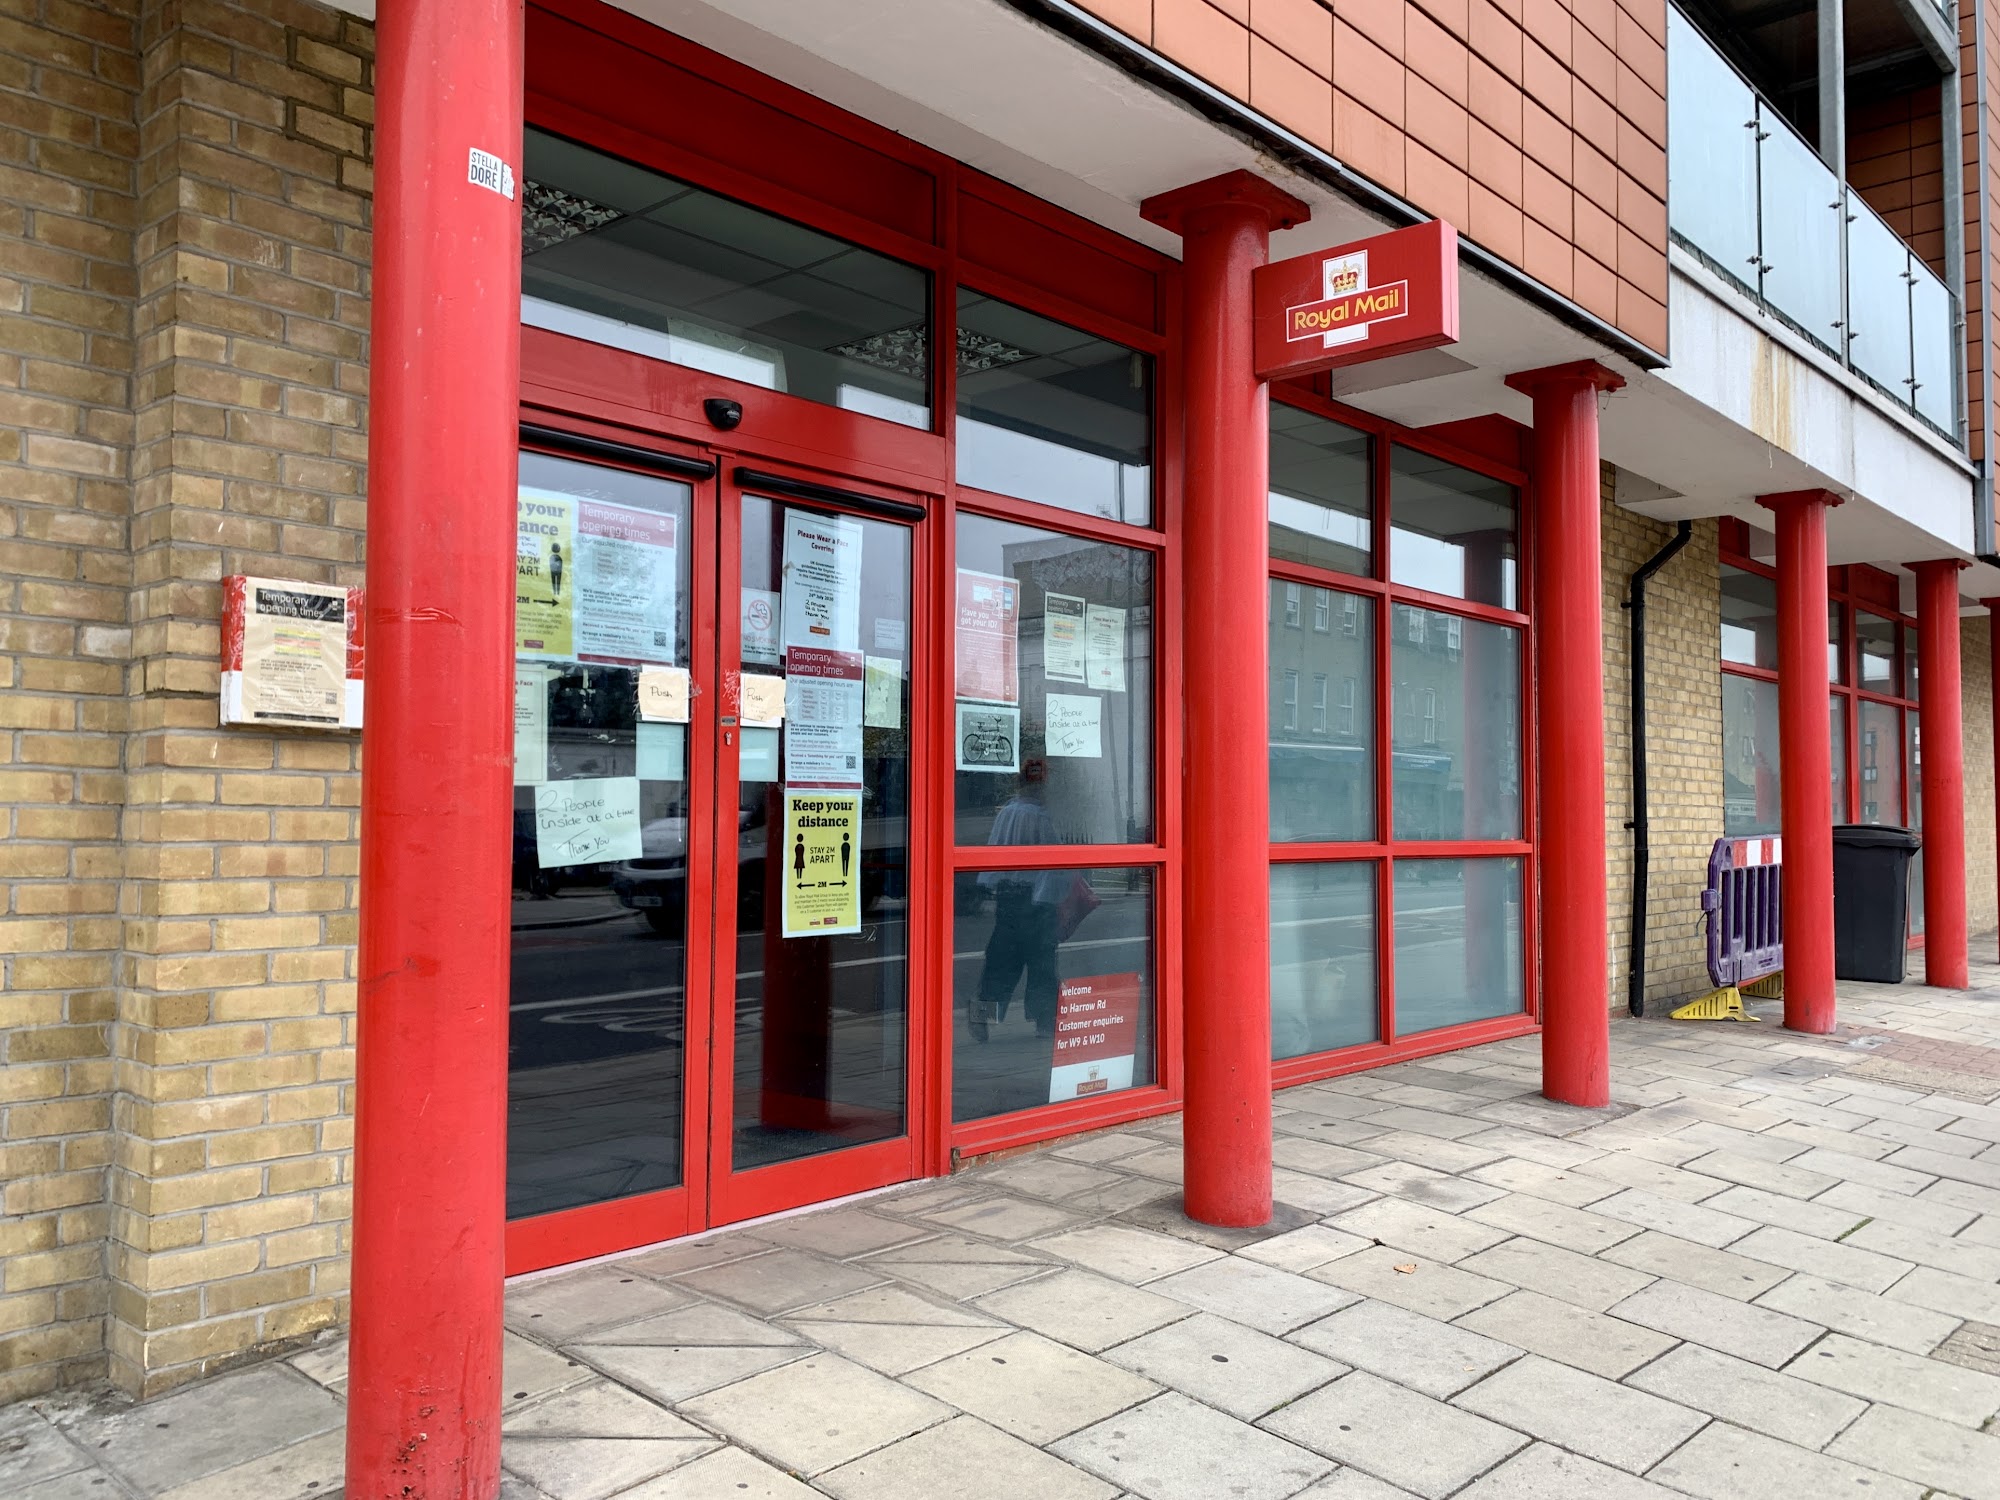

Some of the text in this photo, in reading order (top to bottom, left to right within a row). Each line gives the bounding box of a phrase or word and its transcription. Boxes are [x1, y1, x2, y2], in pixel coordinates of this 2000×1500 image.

[471, 151, 498, 172] STELLA
[470, 164, 498, 190] DORE
[1294, 288, 1399, 331] Royal Mail
[526, 502, 565, 518] your
[583, 504, 635, 524] Temporary
[518, 521, 559, 536] ance
[582, 521, 650, 541] opening times
[797, 529, 816, 540] Please
[817, 534, 832, 543] Wear
[811, 542, 835, 555] Covering
[260, 590, 309, 607] Temporary
[1048, 597, 1068, 608] Temporary
[260, 602, 324, 618] opening times
[961, 607, 989, 619] Have you
[960, 617, 998, 629] got your ID?
[790, 648, 832, 664] Temporary
[790, 663, 844, 676] opening times
[650, 686, 673, 698] Push
[746, 687, 763, 702] Push
[1047, 699, 1058, 717] 2
[1048, 716, 1071, 729] inside
[537, 790, 605, 814] 2 People
[793, 799, 854, 814] Keep your
[538, 813, 581, 830] inside
[586, 814, 602, 823] at
[604, 812, 614, 820] a
[798, 816, 848, 828] distance
[594, 837, 610, 850] You
[810, 846, 835, 854] STAY 2M
[810, 855, 835, 864] APART
[1062, 986, 1092, 997] welcome
[1060, 999, 1106, 1014] to Harrow Rd
[1058, 1014, 1124, 1032] Customer enquiries
[1057, 1033, 1105, 1050] for W9 & W10
[1079, 1082, 1095, 1093] Royal
